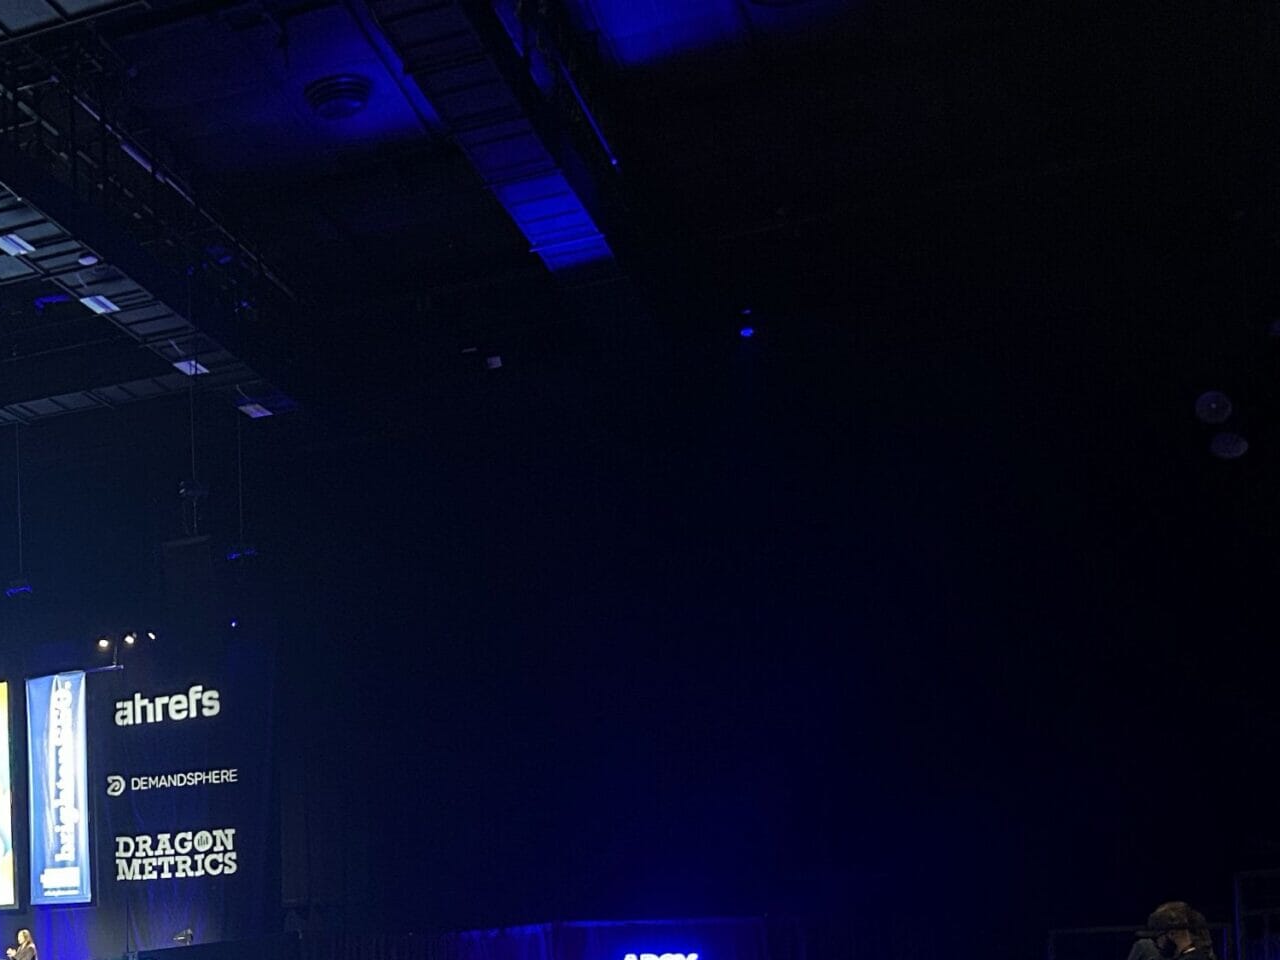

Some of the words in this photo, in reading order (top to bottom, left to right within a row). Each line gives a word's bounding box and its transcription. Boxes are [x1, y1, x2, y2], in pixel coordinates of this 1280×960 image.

[115, 685, 220, 726] ahrefs
[131, 769, 238, 790] DEMANDSPHERE
[115, 828, 236, 858] DRAGON
[116, 852, 237, 881] METRICS
